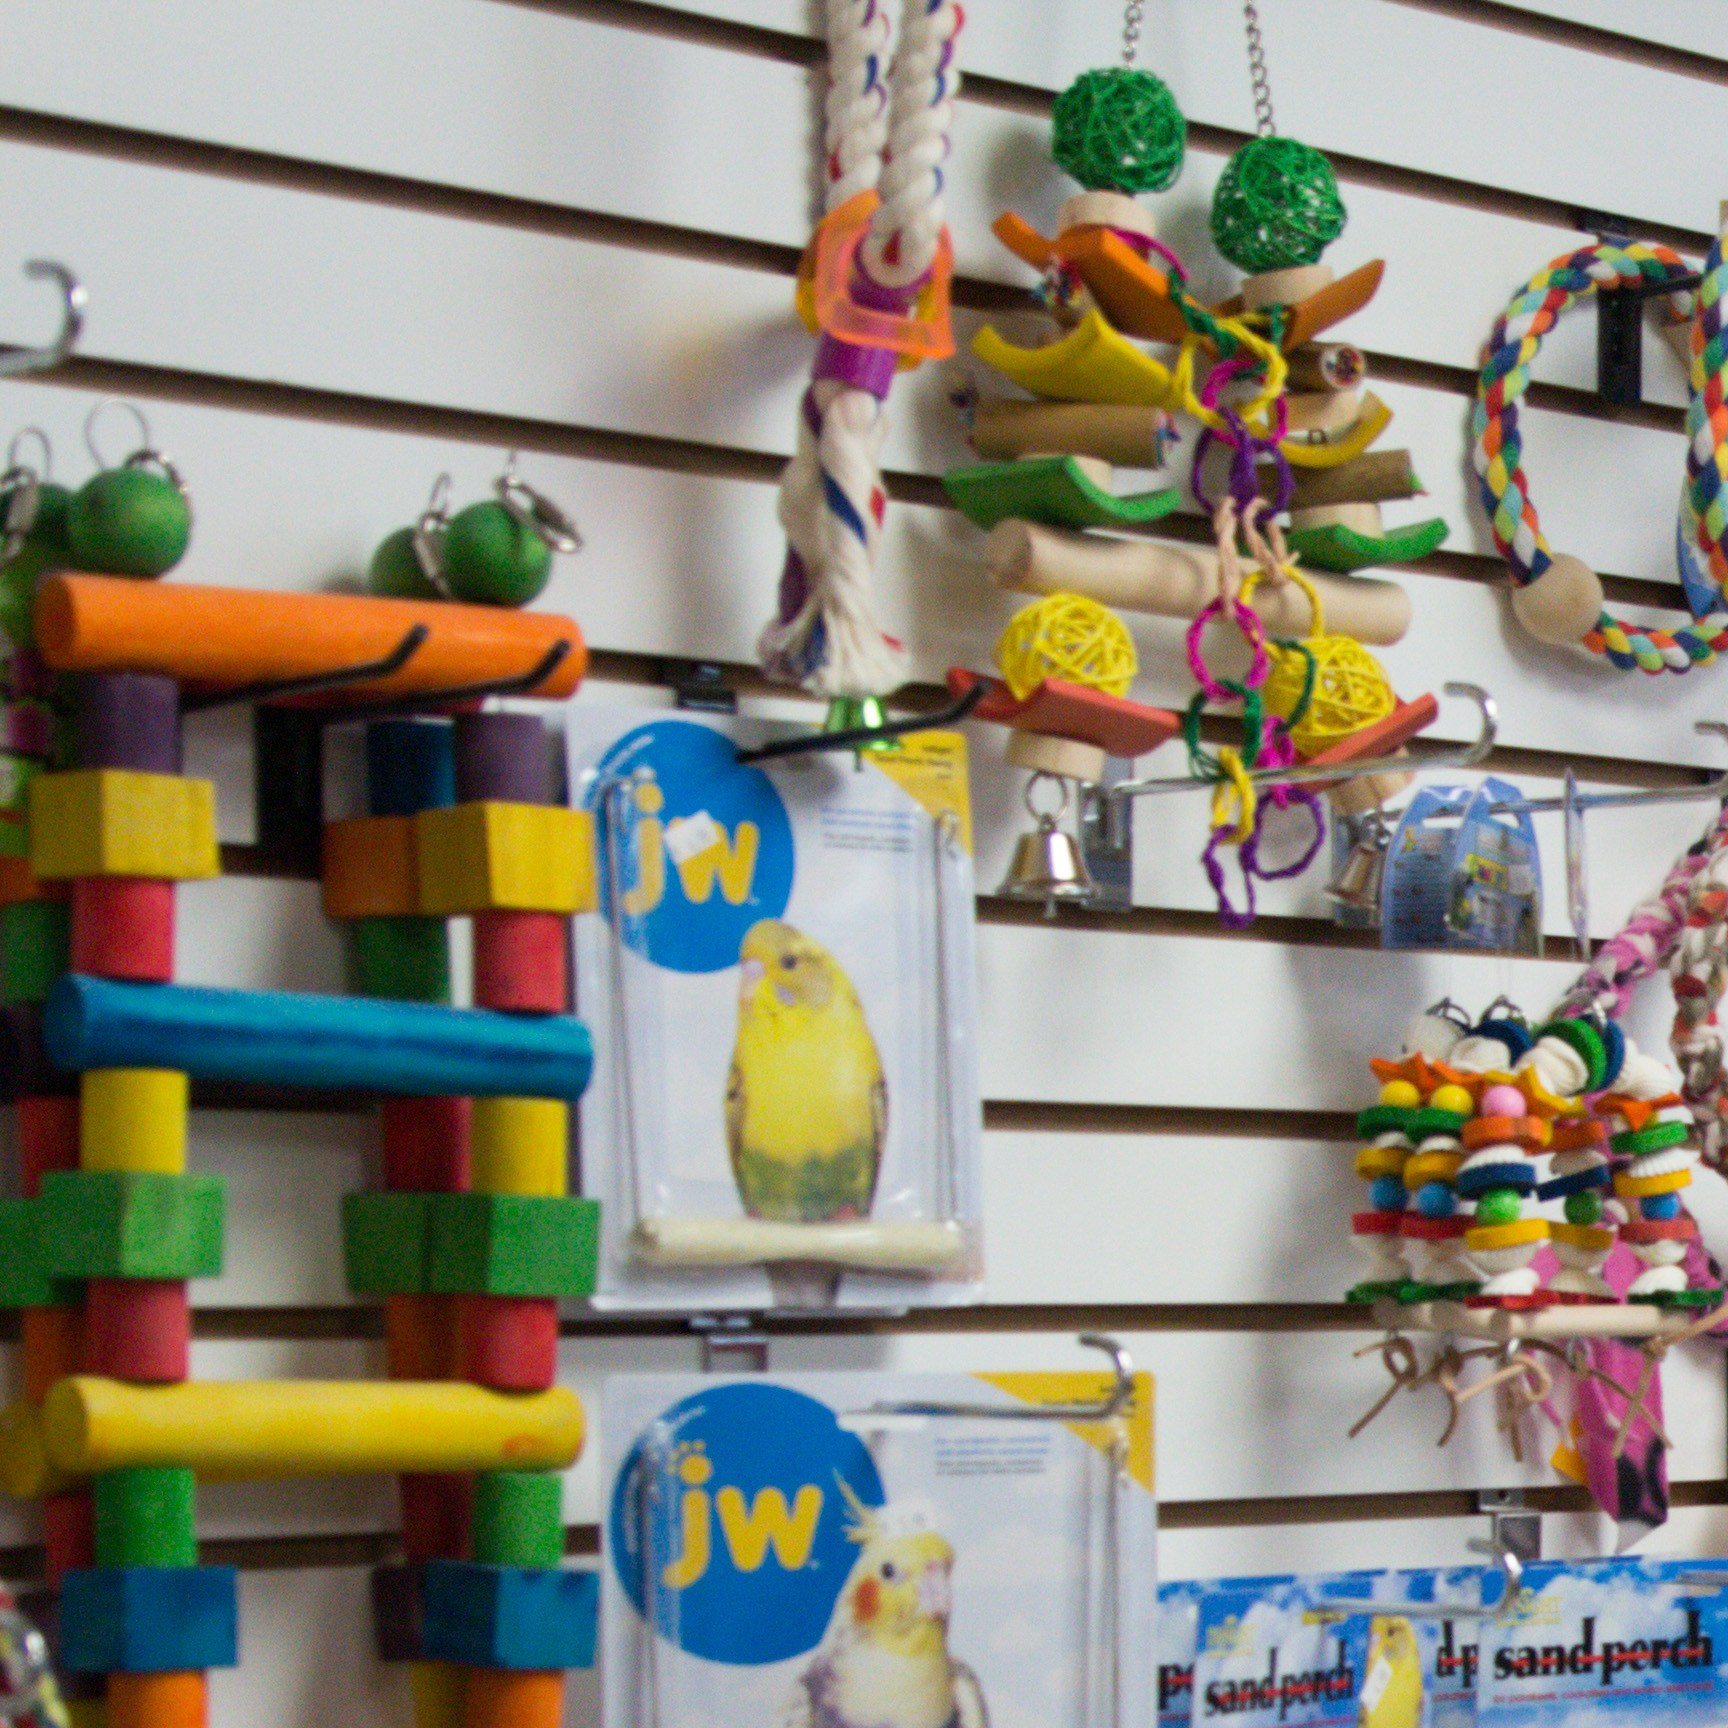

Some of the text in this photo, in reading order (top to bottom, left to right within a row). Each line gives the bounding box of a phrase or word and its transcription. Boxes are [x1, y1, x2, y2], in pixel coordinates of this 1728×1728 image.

[663, 1451, 824, 1590] jw
[1205, 1646, 1278, 1717] sand
[1279, 1638, 1354, 1722] perch
[1493, 1615, 1597, 1681] sand
[1600, 1609, 1714, 1686] perch
